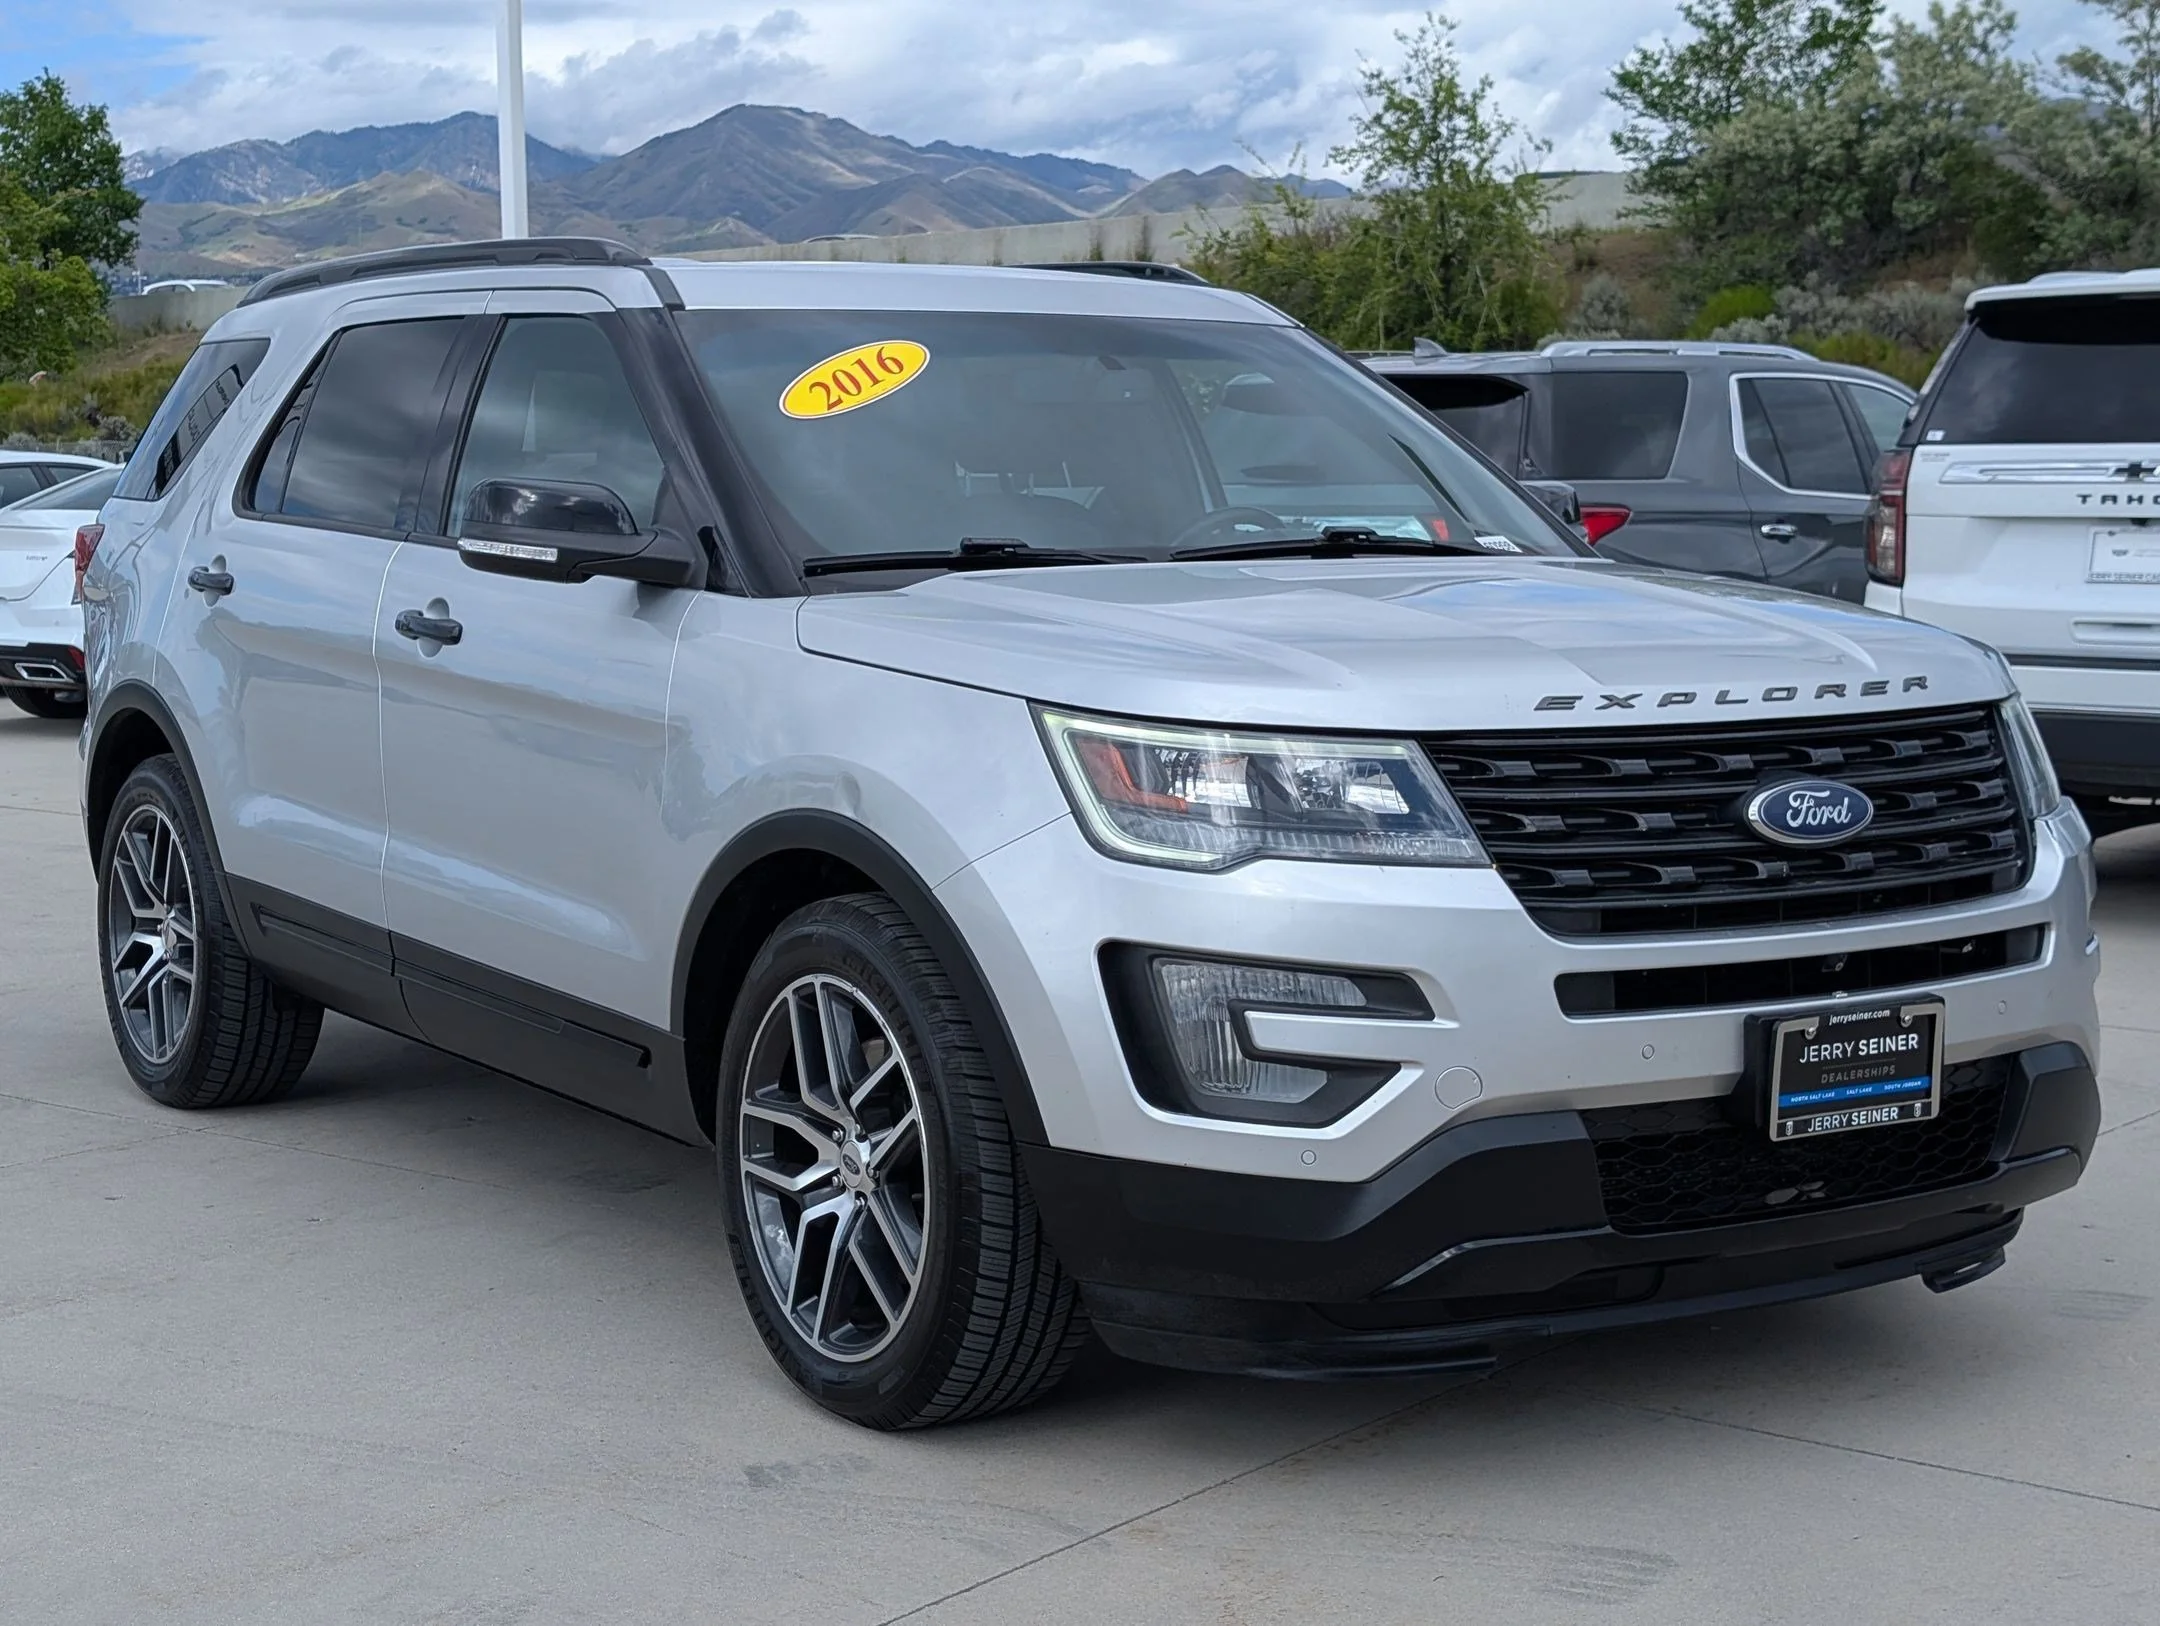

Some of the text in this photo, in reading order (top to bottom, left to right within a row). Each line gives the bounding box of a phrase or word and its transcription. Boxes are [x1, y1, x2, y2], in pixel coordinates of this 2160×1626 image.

[809, 346, 904, 411] 2016
[1533, 675, 1929, 712] EXPLORER
[1786, 789, 1852, 828] Ford
[1829, 1009, 1891, 1026] jerryseiner.com
[1799, 1033, 1918, 1063] JERRY SEINER
[1820, 1064, 1896, 1084] DEALERSHIPS
[1807, 1106, 1899, 1133] JERRY SEINER
